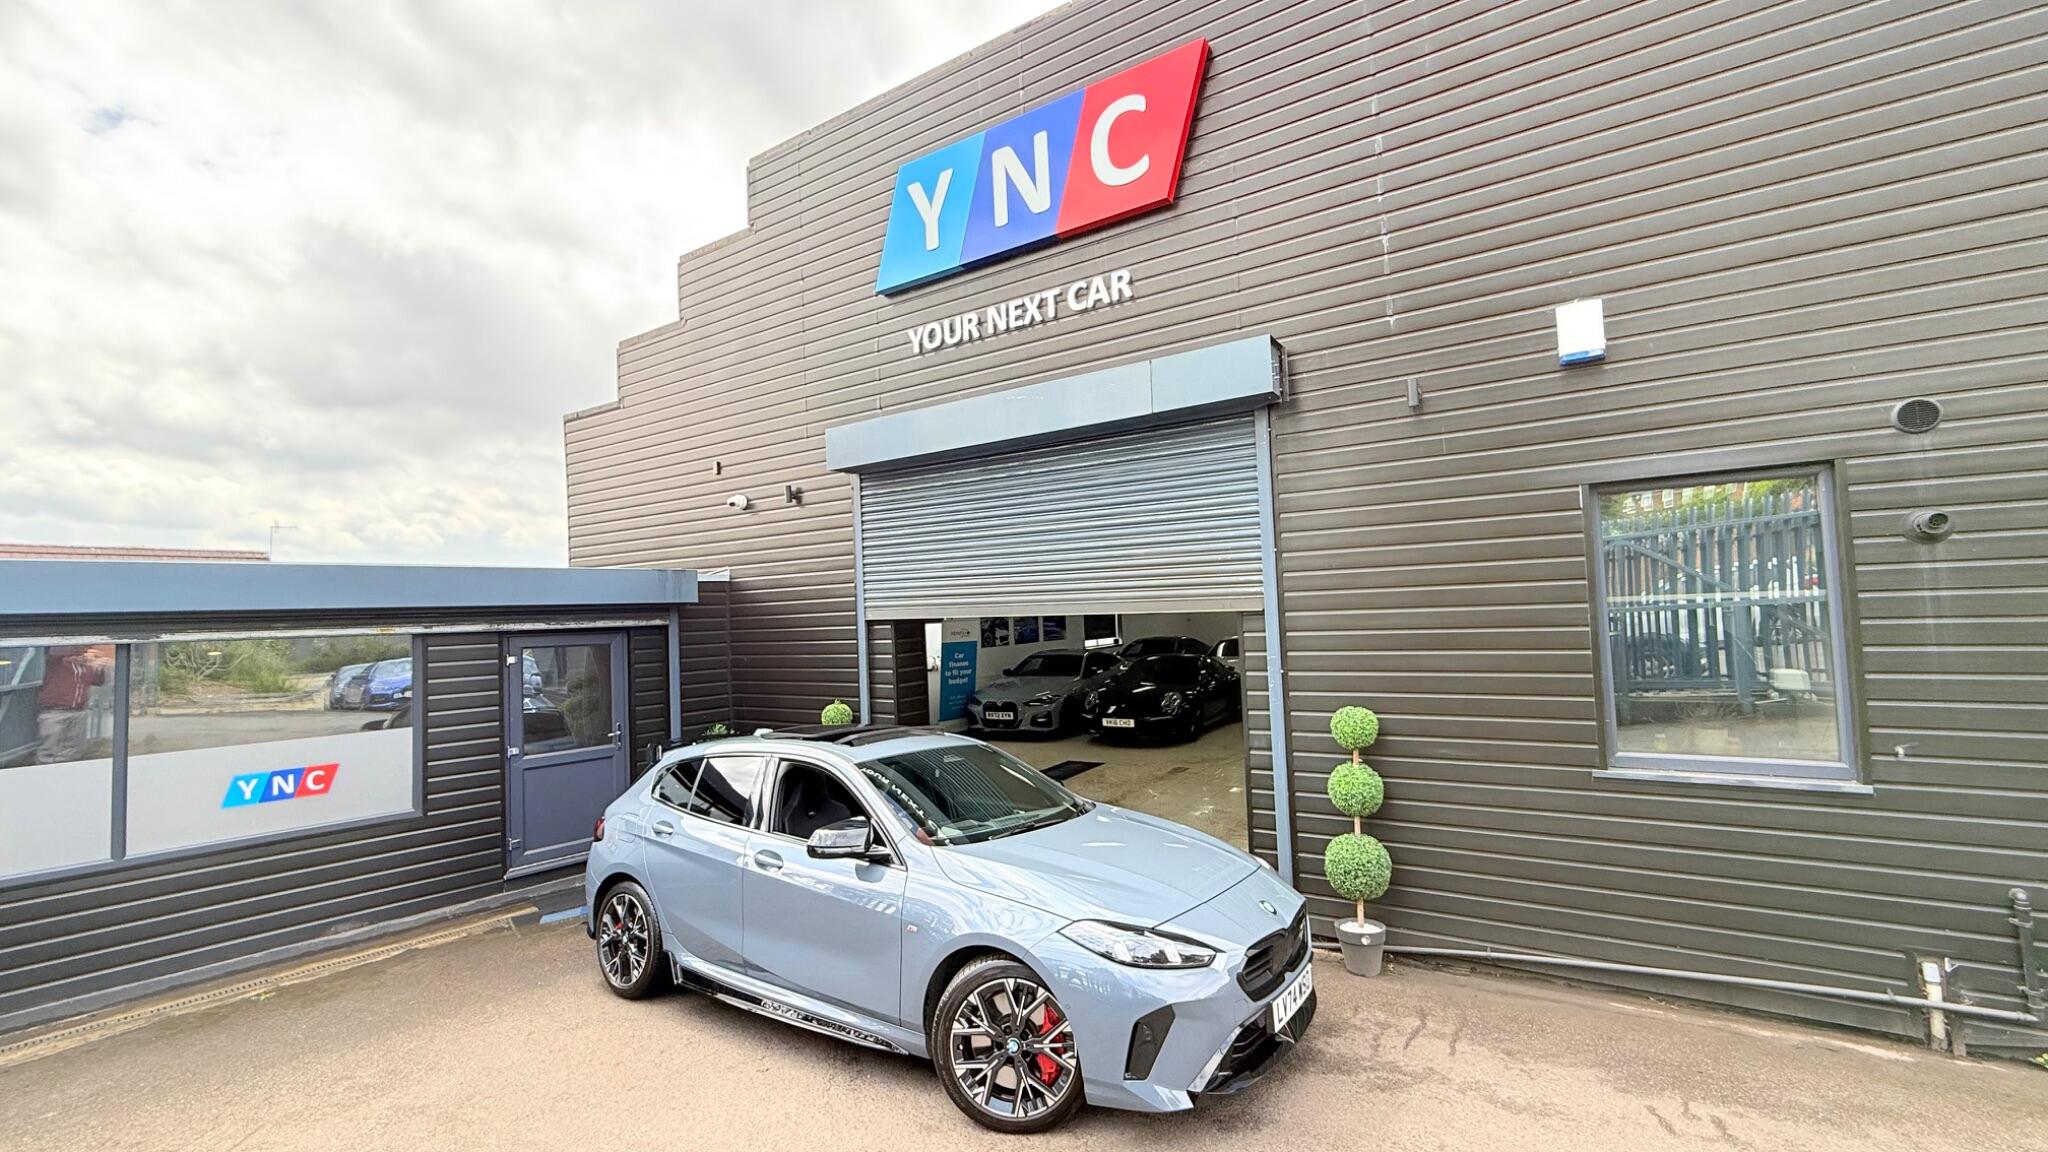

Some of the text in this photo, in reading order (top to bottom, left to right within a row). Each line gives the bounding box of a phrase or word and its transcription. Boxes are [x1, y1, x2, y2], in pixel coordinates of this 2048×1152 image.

[907, 93, 1151, 252] YNC
[907, 269, 1133, 354] YOUR NEXT CAR
[237, 769, 326, 801] YNC
